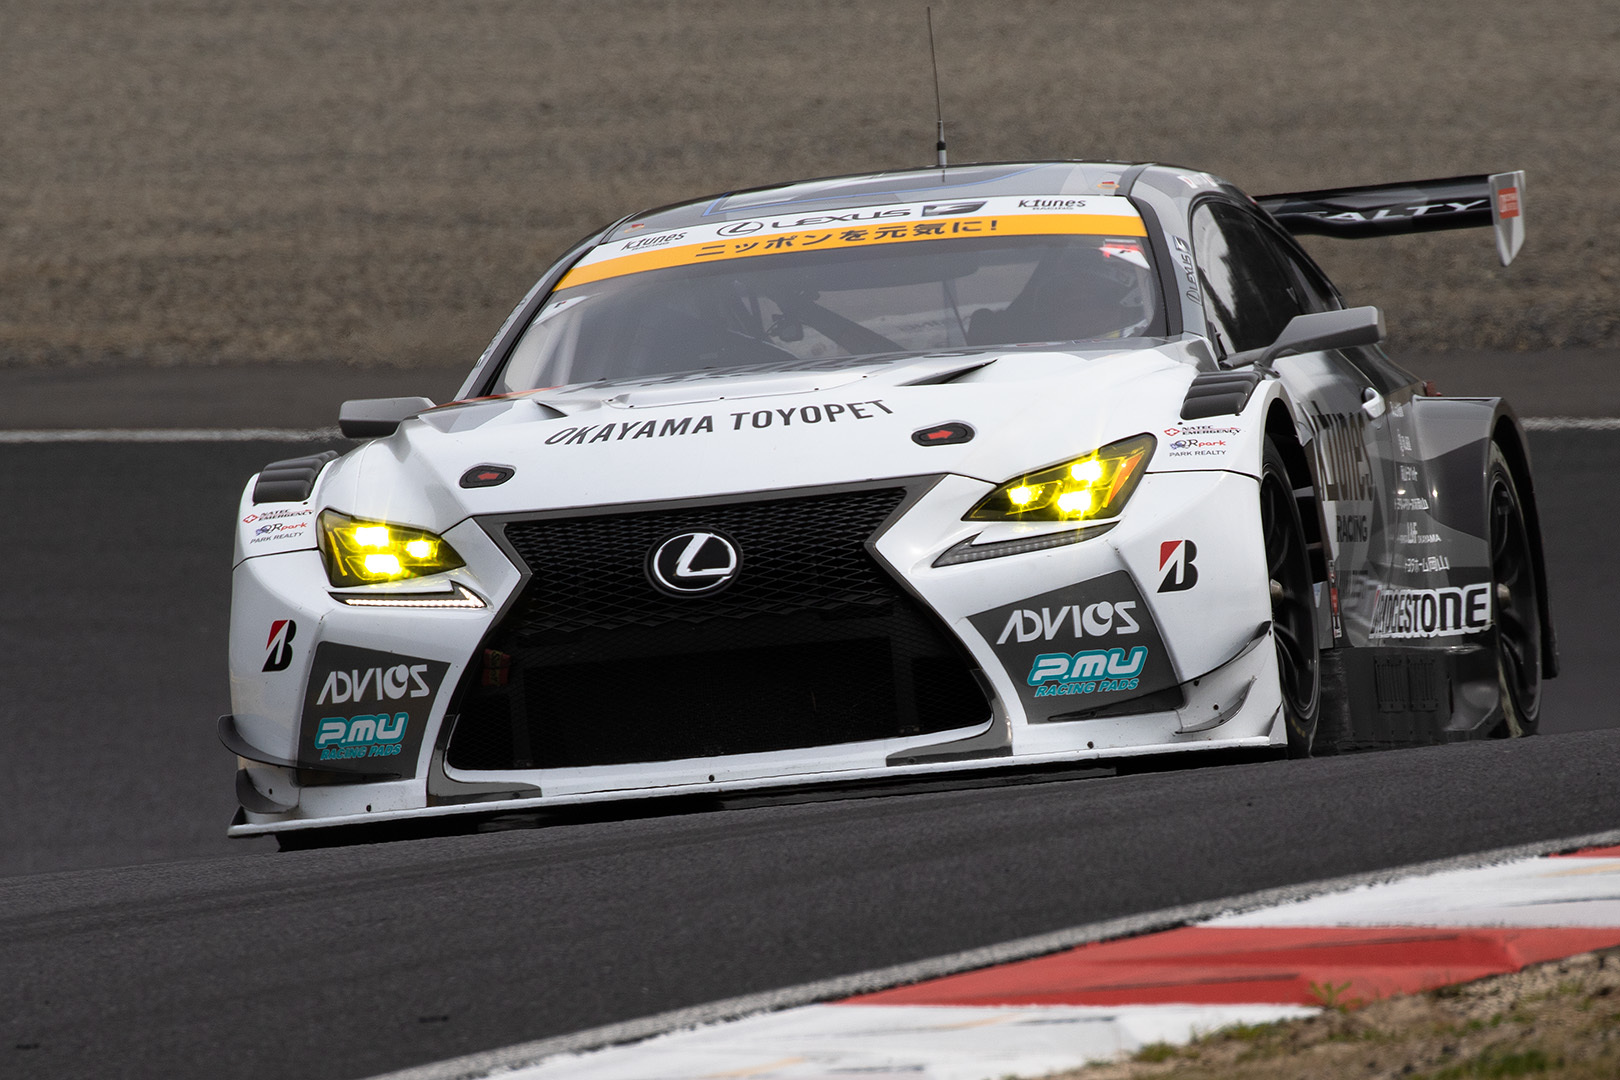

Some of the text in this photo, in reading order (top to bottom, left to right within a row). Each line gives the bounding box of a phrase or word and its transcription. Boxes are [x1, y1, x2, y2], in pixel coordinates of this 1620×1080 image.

[695, 219, 998, 257] ニッポンを元気に!
[772, 208, 911, 228] LEXUS
[544, 400, 894, 446] OKAYAMA TOYOPET
[996, 601, 1140, 645] ADVICS
[1369, 583, 1492, 639] BRIDGESTONE
[316, 664, 431, 706] ADVICS
[1034, 678, 1139, 698] RACING PADS
[320, 744, 403, 761] RACING PADS
